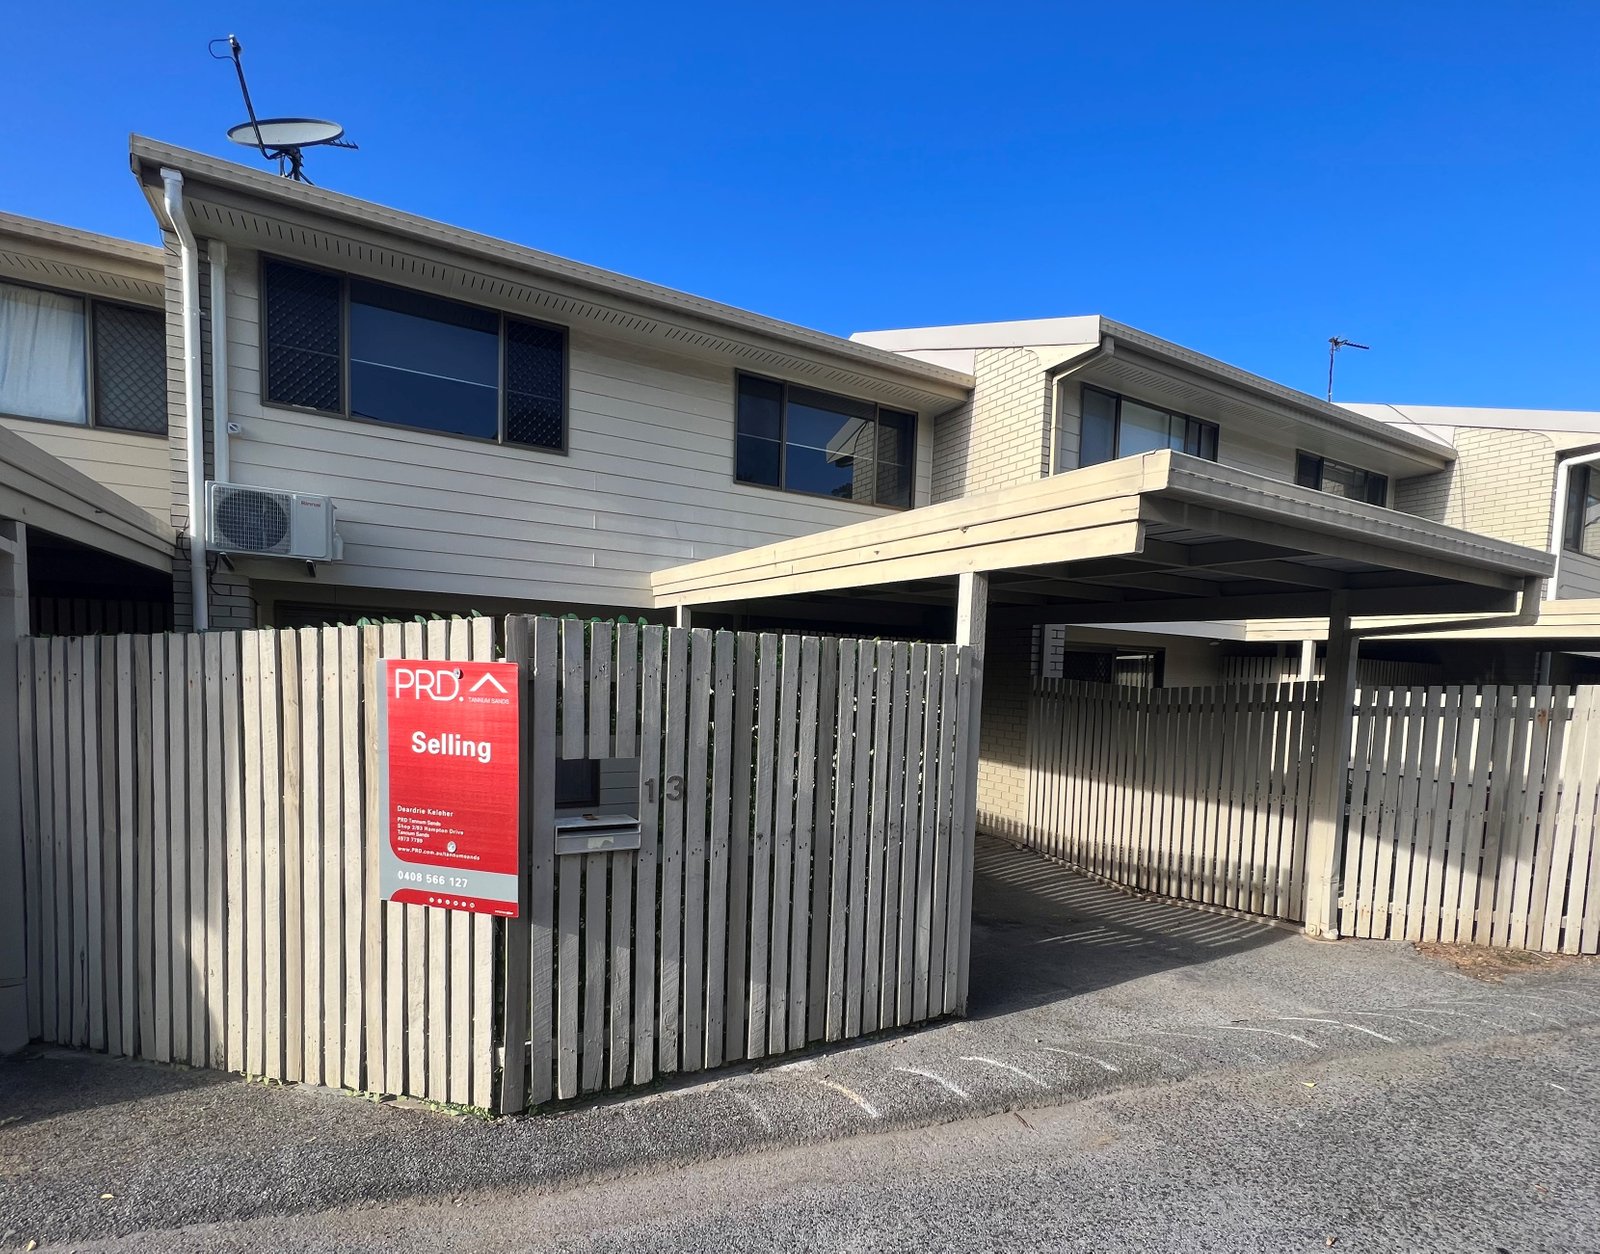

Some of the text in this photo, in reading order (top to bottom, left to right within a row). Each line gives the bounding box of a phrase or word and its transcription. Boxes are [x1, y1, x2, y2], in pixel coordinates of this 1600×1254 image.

[411, 730, 492, 764] Selling
[644, 775, 685, 803] 13
[397, 870, 468, 888] 0408 566 127
